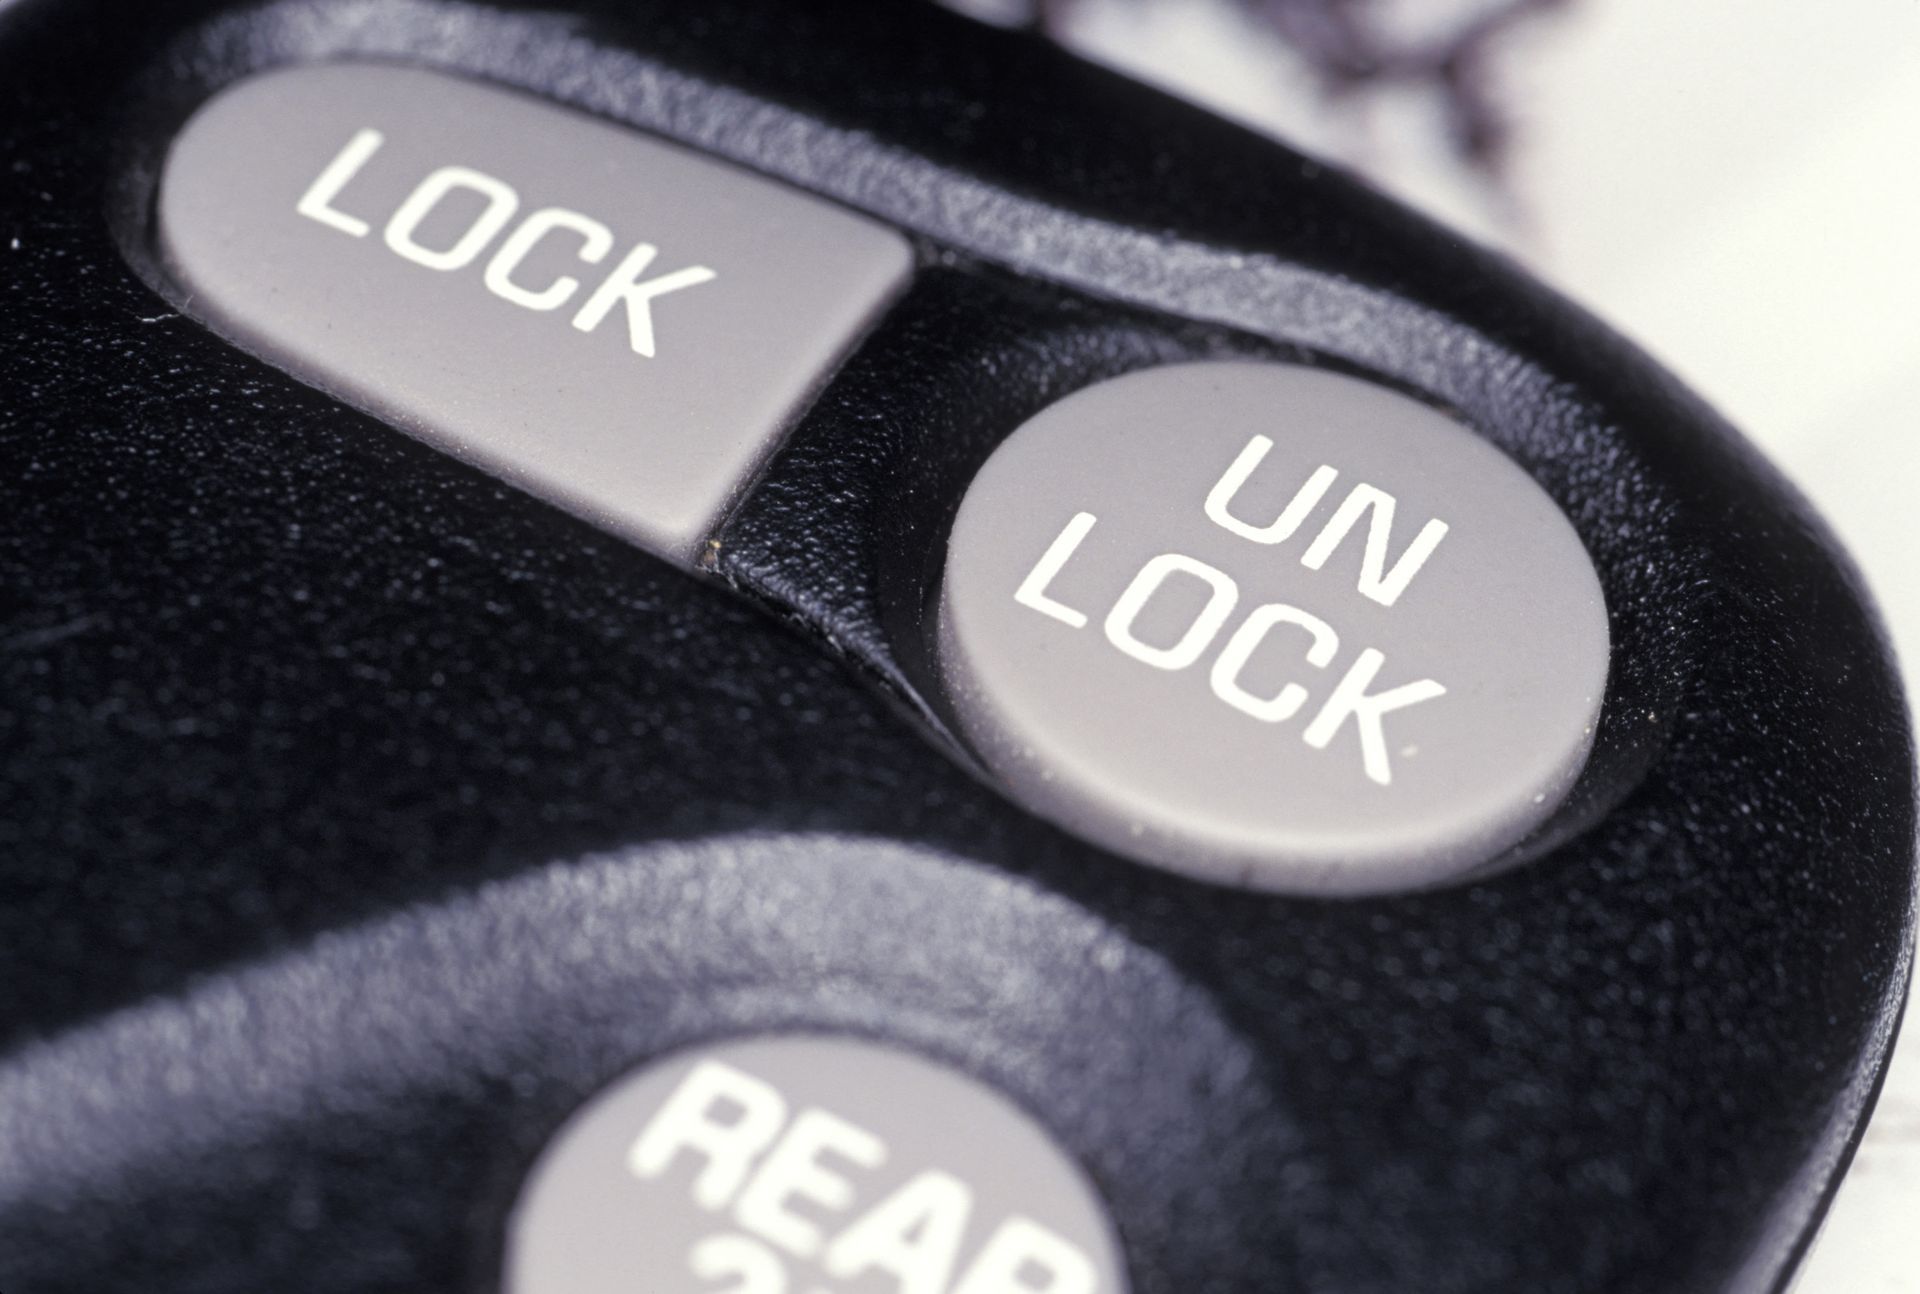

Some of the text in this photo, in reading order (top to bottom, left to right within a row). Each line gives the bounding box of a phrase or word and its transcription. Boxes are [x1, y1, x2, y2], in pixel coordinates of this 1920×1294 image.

[299, 130, 715, 358] LOCK
[1204, 433, 1449, 607] UN
[1014, 511, 1447, 786] LOCK
